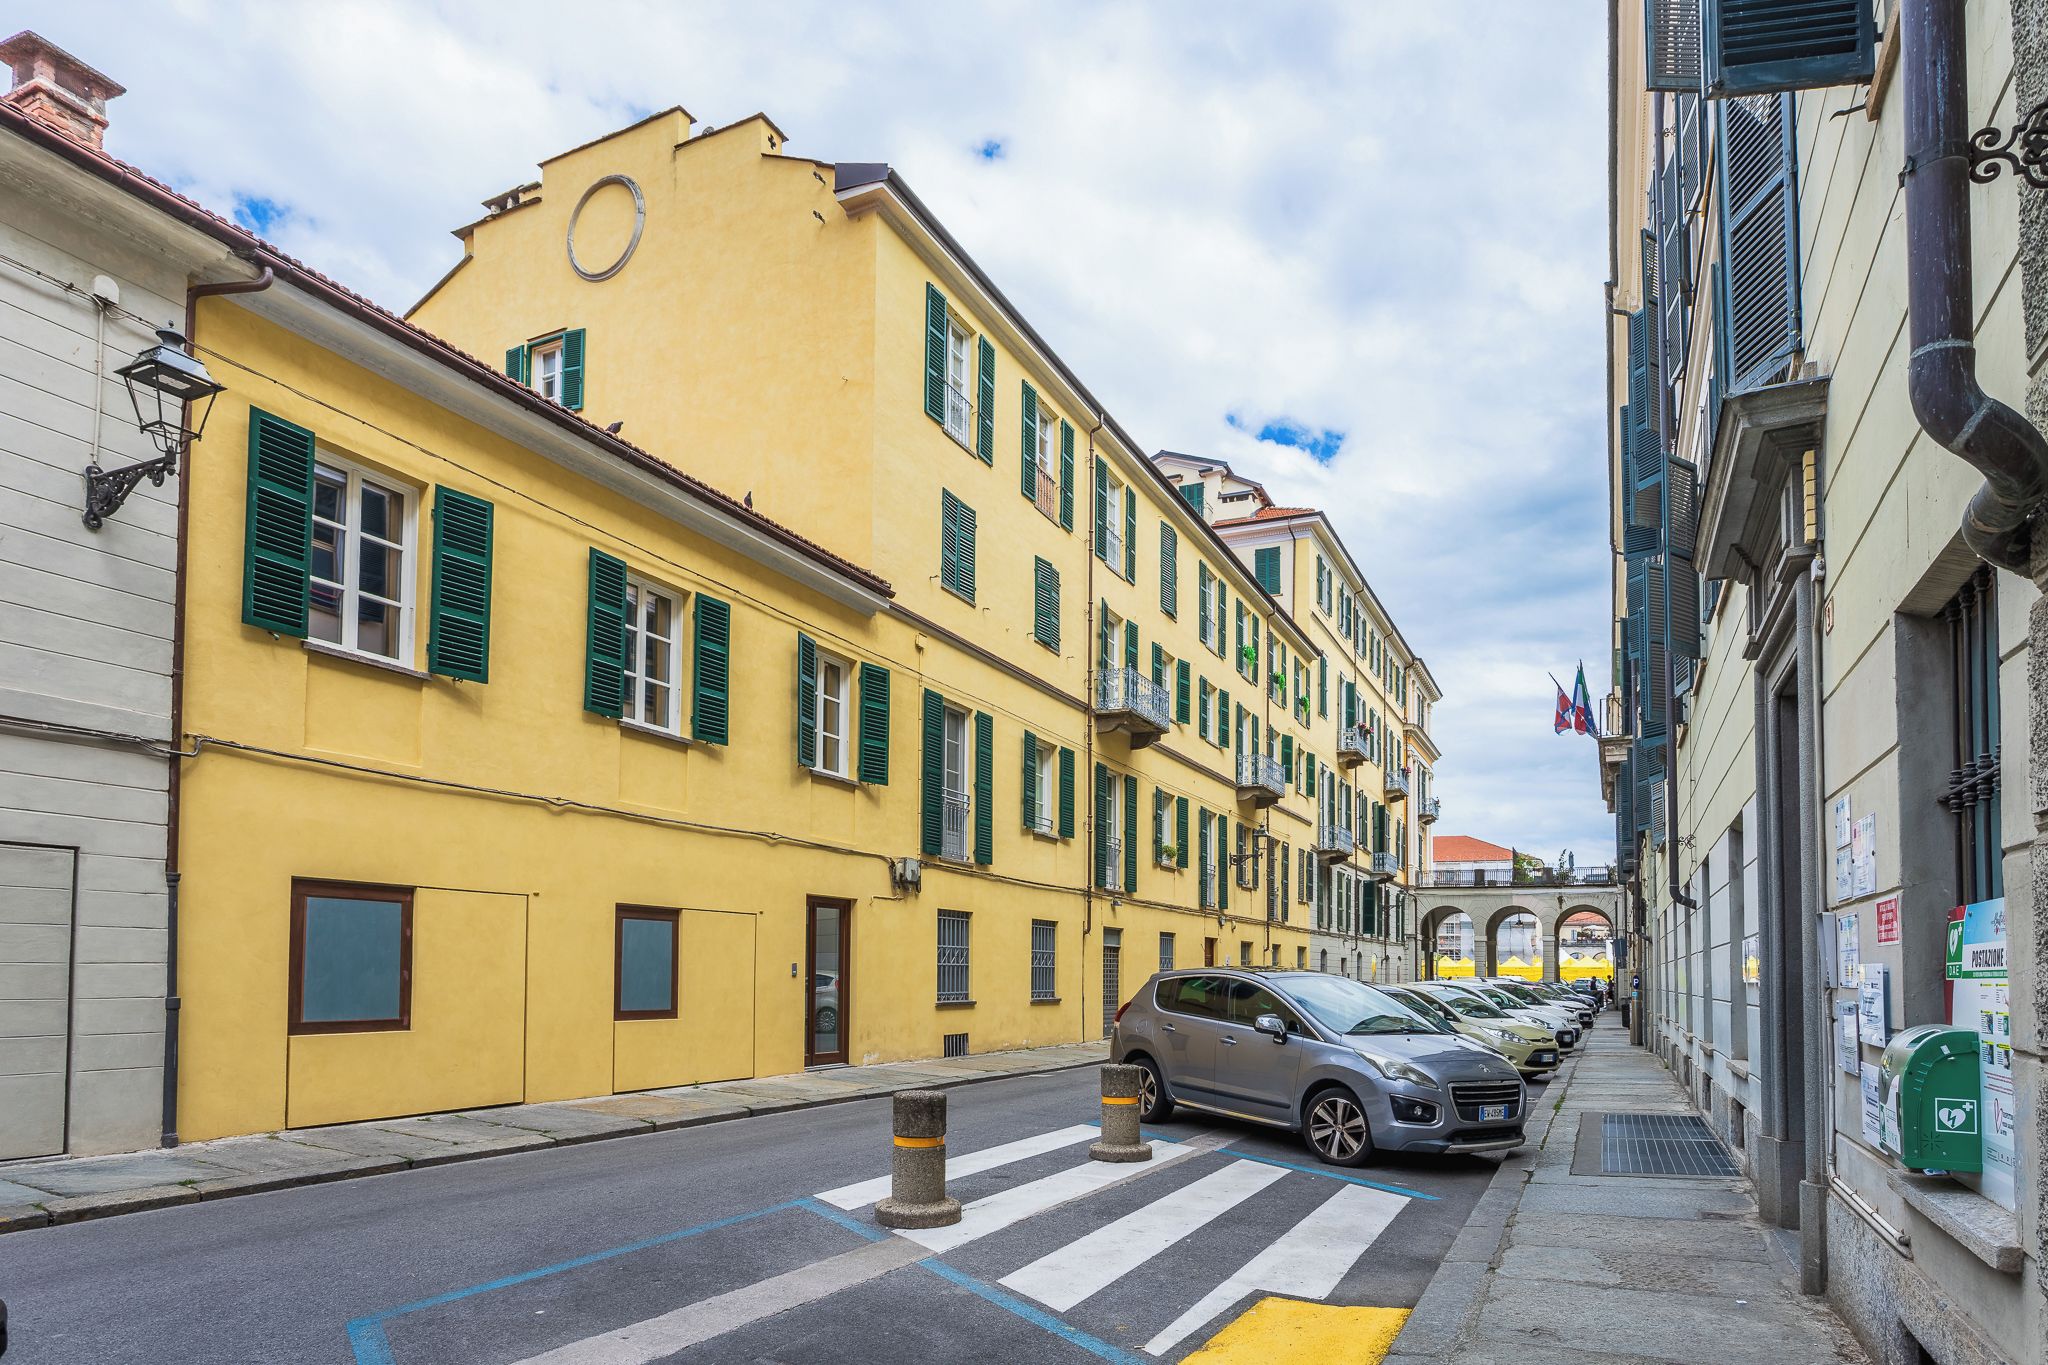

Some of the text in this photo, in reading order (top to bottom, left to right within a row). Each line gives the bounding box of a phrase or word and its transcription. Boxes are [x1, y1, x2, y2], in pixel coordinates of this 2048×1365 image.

[1971, 948, 2003, 968] POSTAZIONE
[1949, 965, 1960, 976] DAE
[1633, 978, 1639, 986] P
